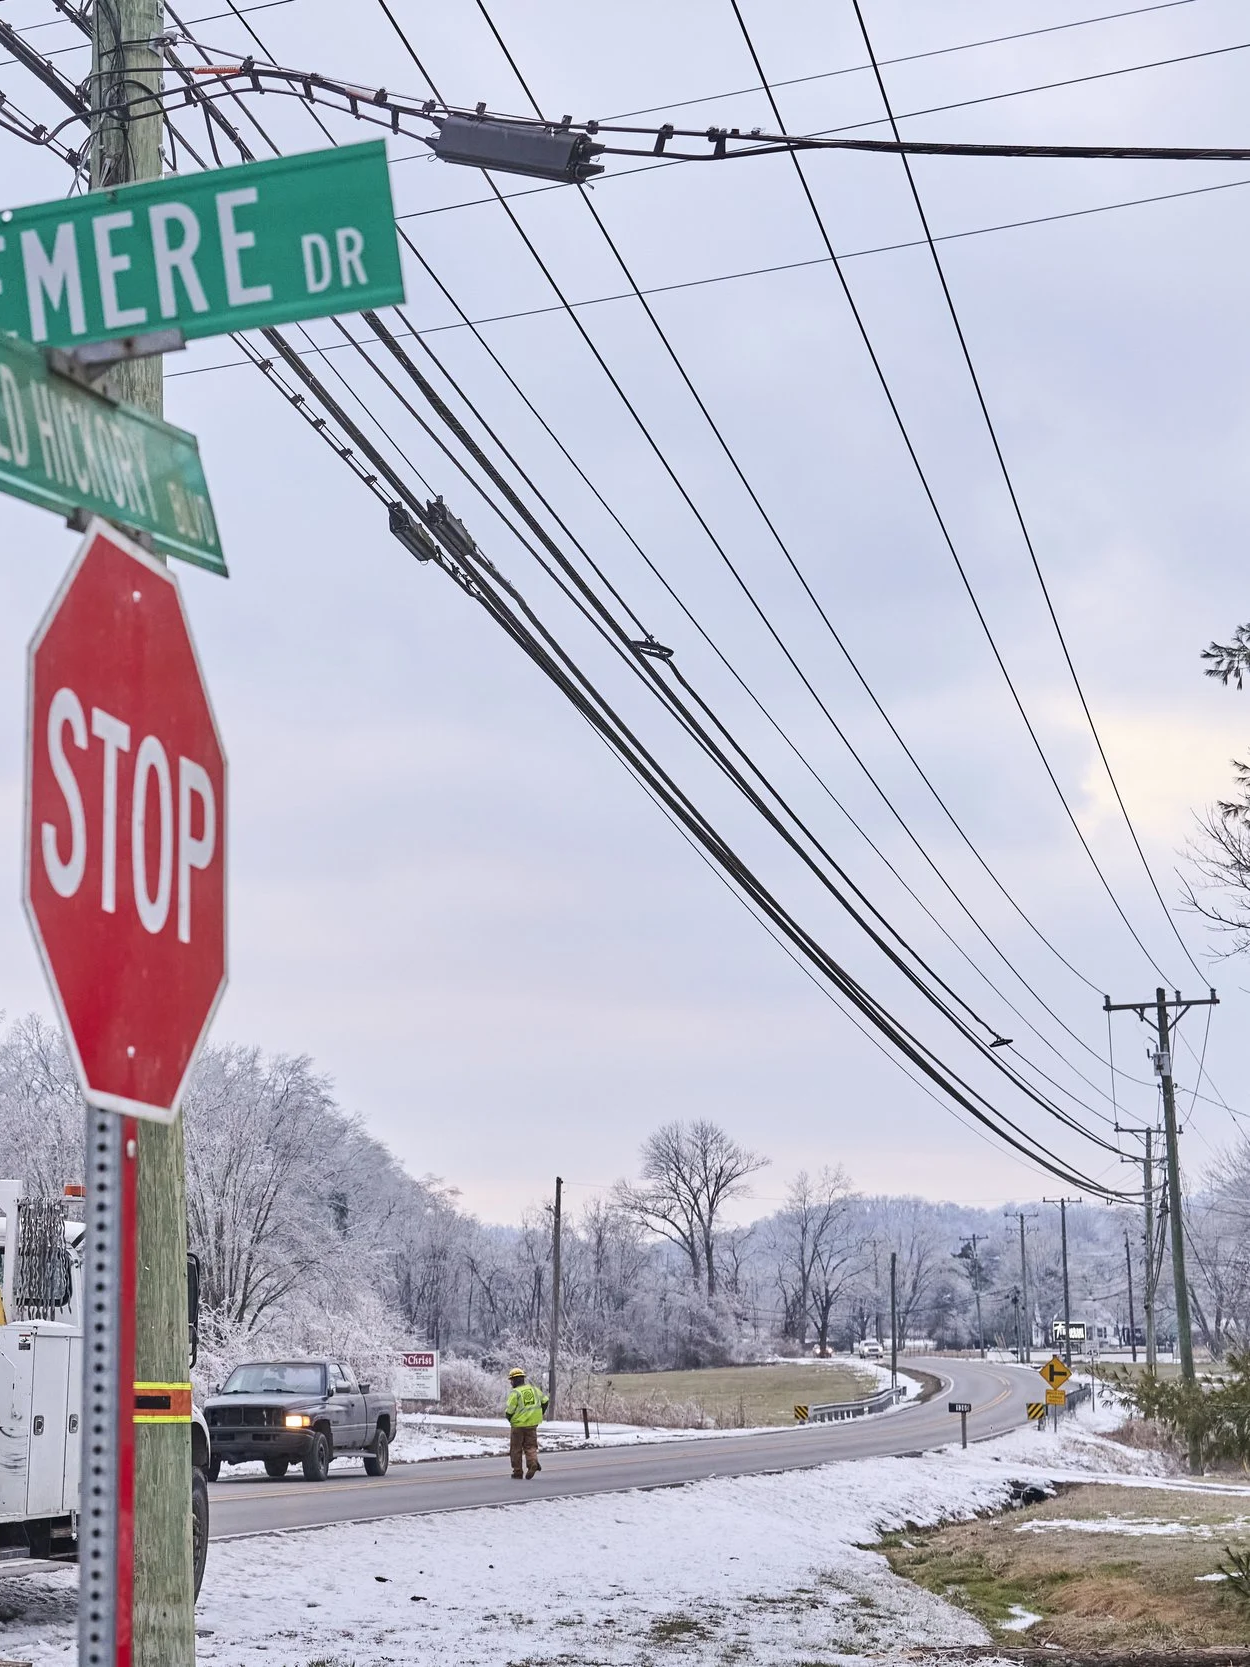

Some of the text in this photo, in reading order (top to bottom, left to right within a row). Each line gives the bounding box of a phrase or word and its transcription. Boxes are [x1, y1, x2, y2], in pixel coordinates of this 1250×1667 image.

[301, 227, 368, 294] DR
[31, 379, 158, 523] HICKORY
[41, 687, 216, 944] STOP
[407, 1354, 432, 1365] Christ
